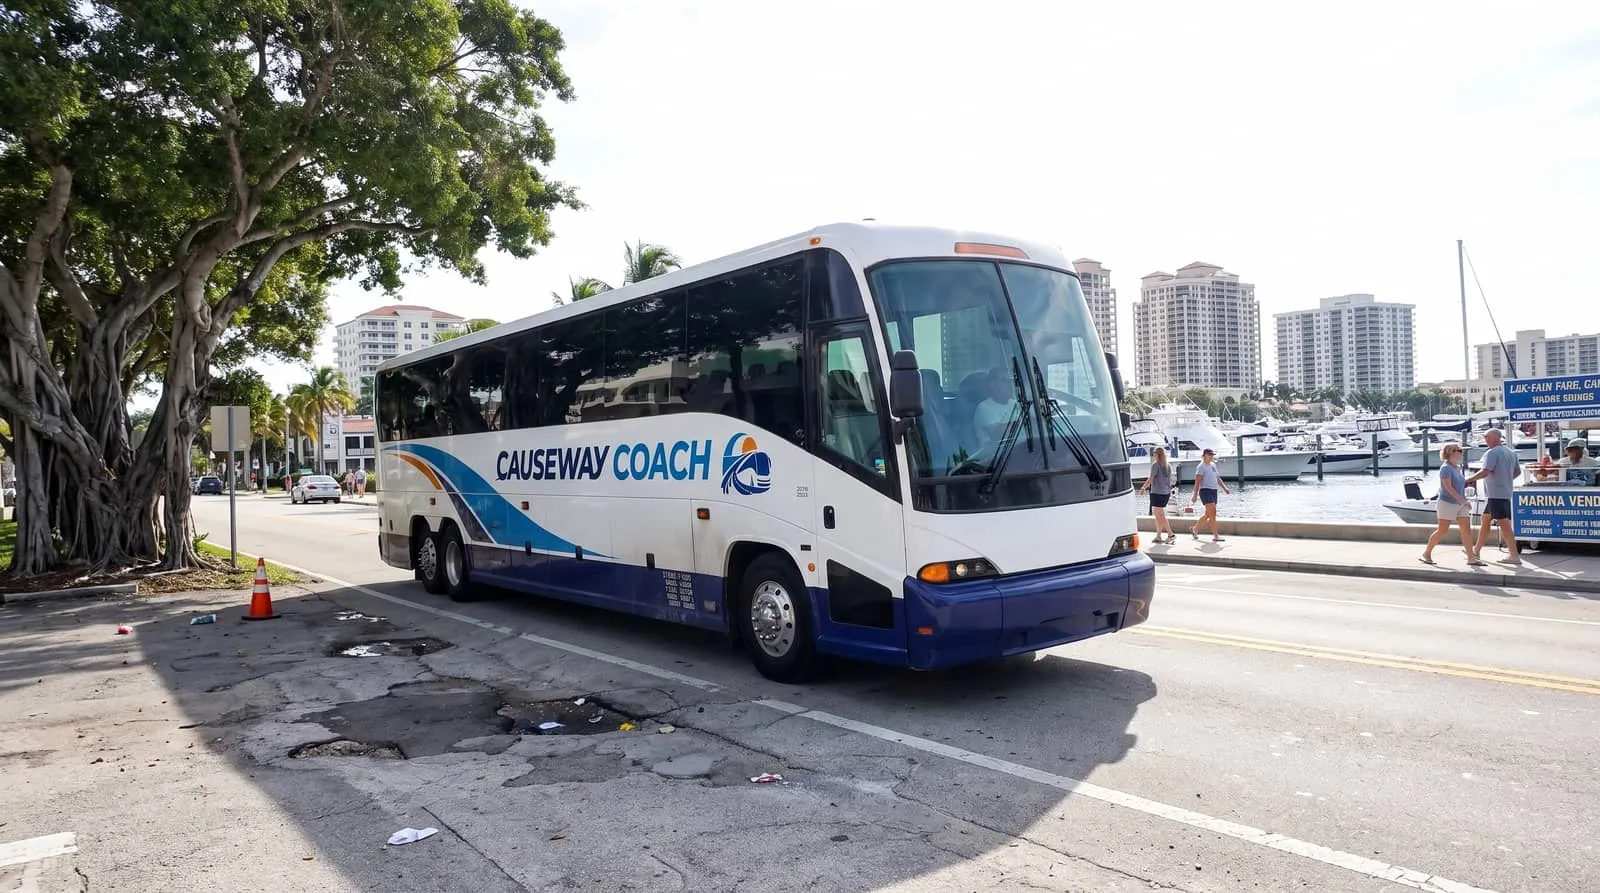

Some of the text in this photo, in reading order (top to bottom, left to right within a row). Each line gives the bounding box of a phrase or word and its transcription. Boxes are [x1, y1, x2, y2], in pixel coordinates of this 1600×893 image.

[495, 439, 712, 481] CAUSEWAY COACH
[1518, 495, 1565, 507] MARINA
